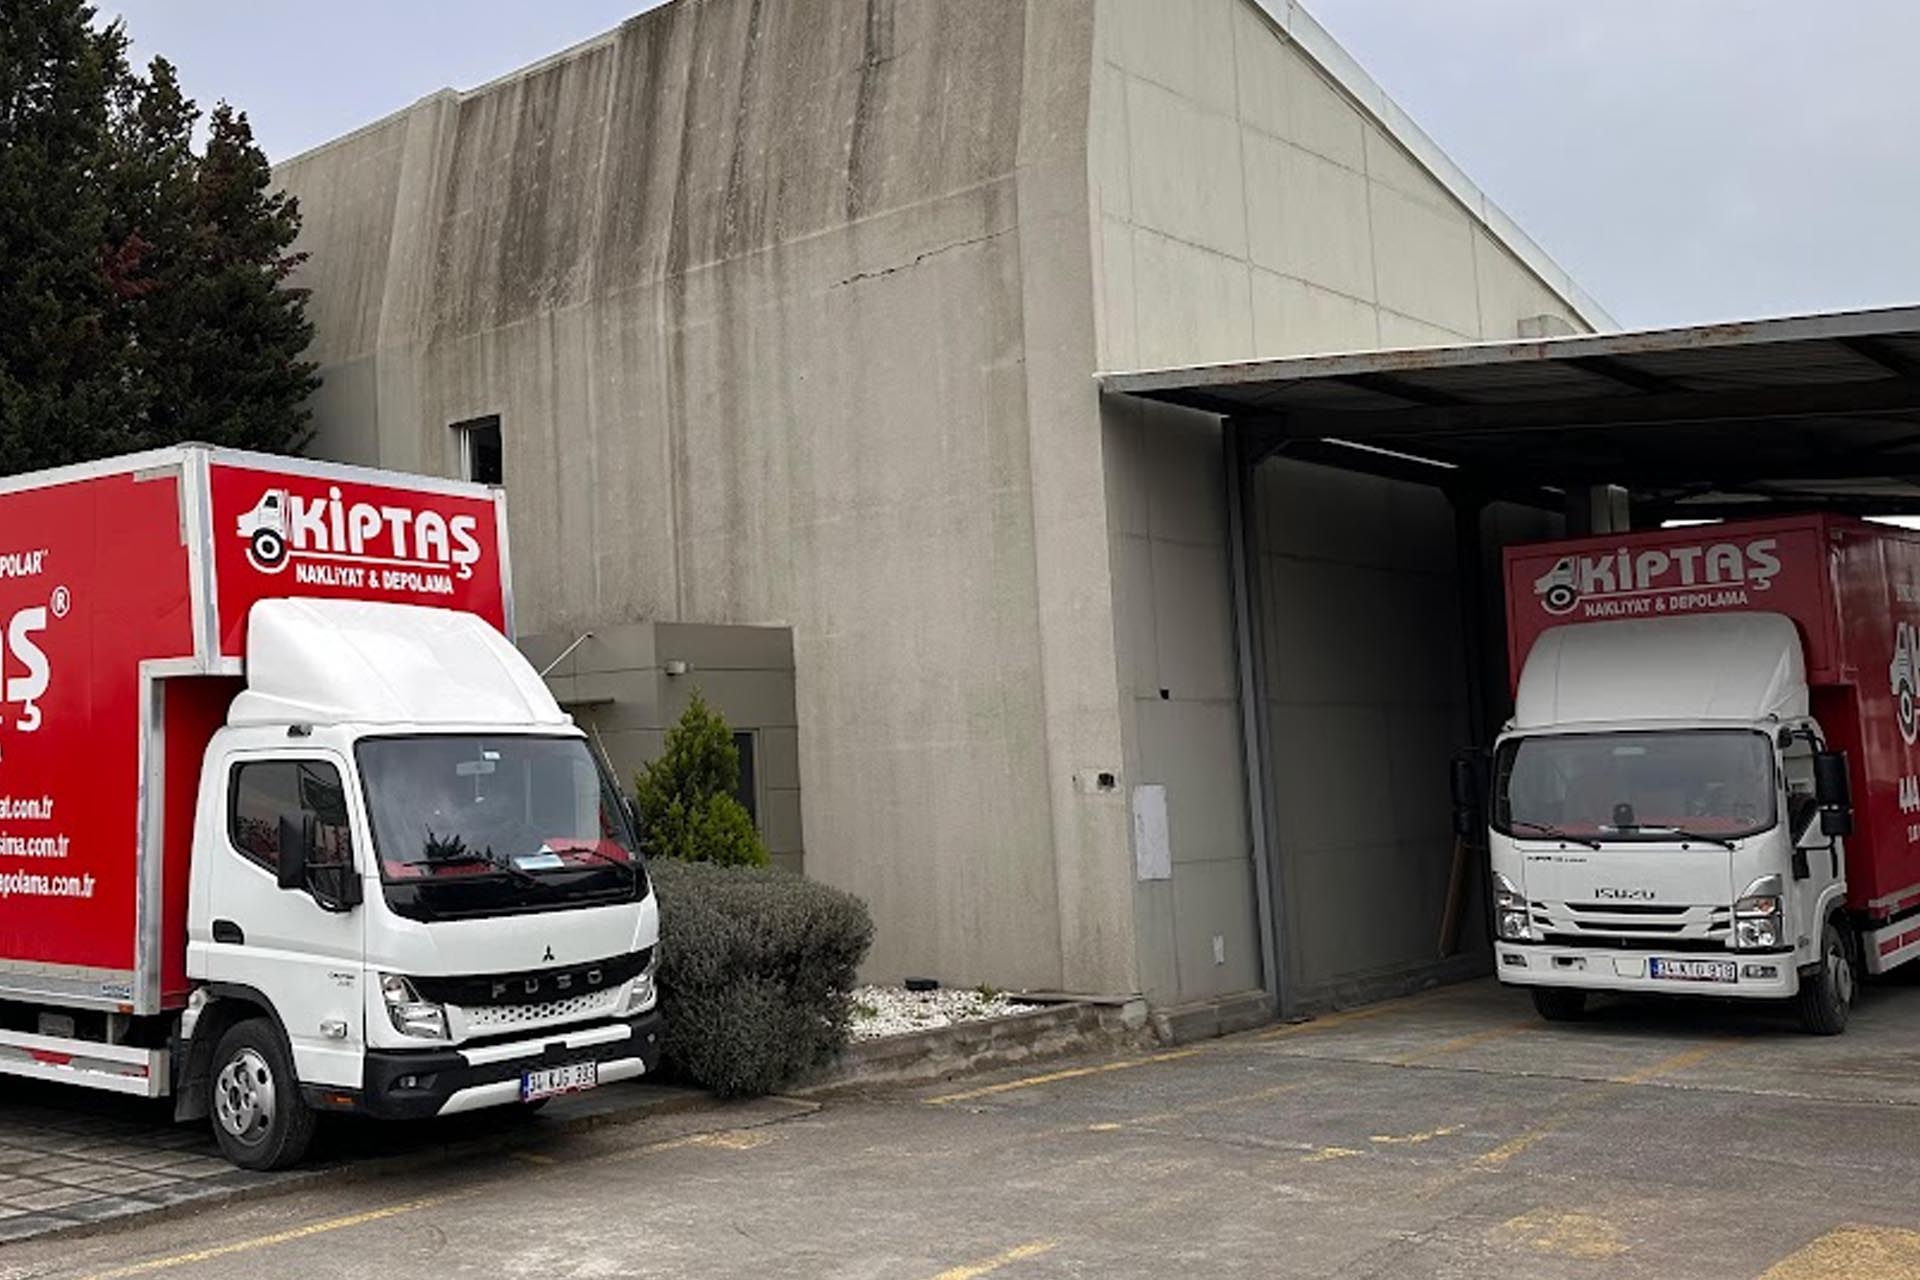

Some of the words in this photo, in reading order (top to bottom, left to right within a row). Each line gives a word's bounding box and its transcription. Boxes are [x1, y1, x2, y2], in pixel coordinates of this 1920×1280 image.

[290, 486, 480, 579] KİPTAŞ
[1581, 539, 1781, 593] KİPTAŞ
[367, 570, 380, 588] &
[382, 571, 454, 594] DEPOLAMA
[1655, 597, 1666, 611] &
[1669, 591, 1748, 609] DEPOLAMA
[1595, 888, 1656, 900] ISUZU
[491, 968, 603, 999] FUSO
